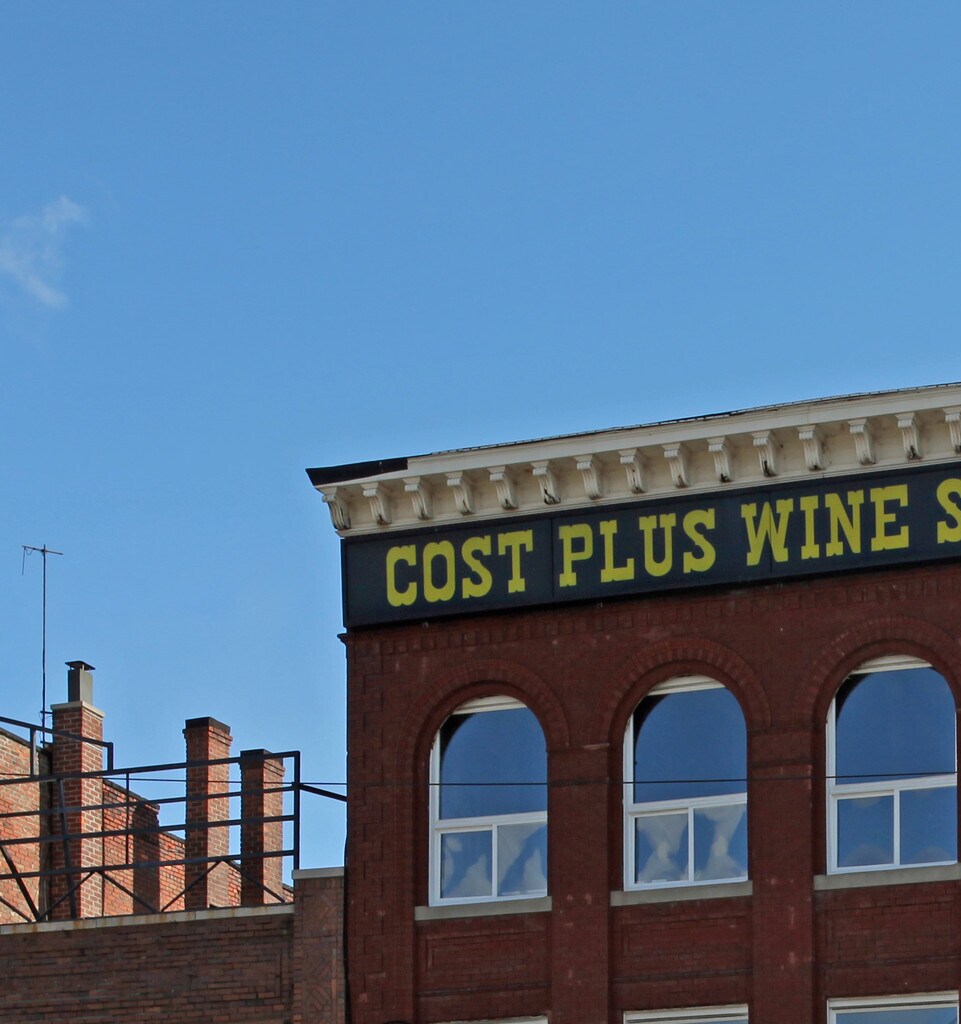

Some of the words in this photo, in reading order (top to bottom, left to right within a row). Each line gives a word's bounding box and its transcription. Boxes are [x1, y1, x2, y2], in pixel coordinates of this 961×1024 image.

[387, 531, 533, 607] COST
[559, 510, 716, 586] PLUS
[741, 484, 910, 565] WINE
